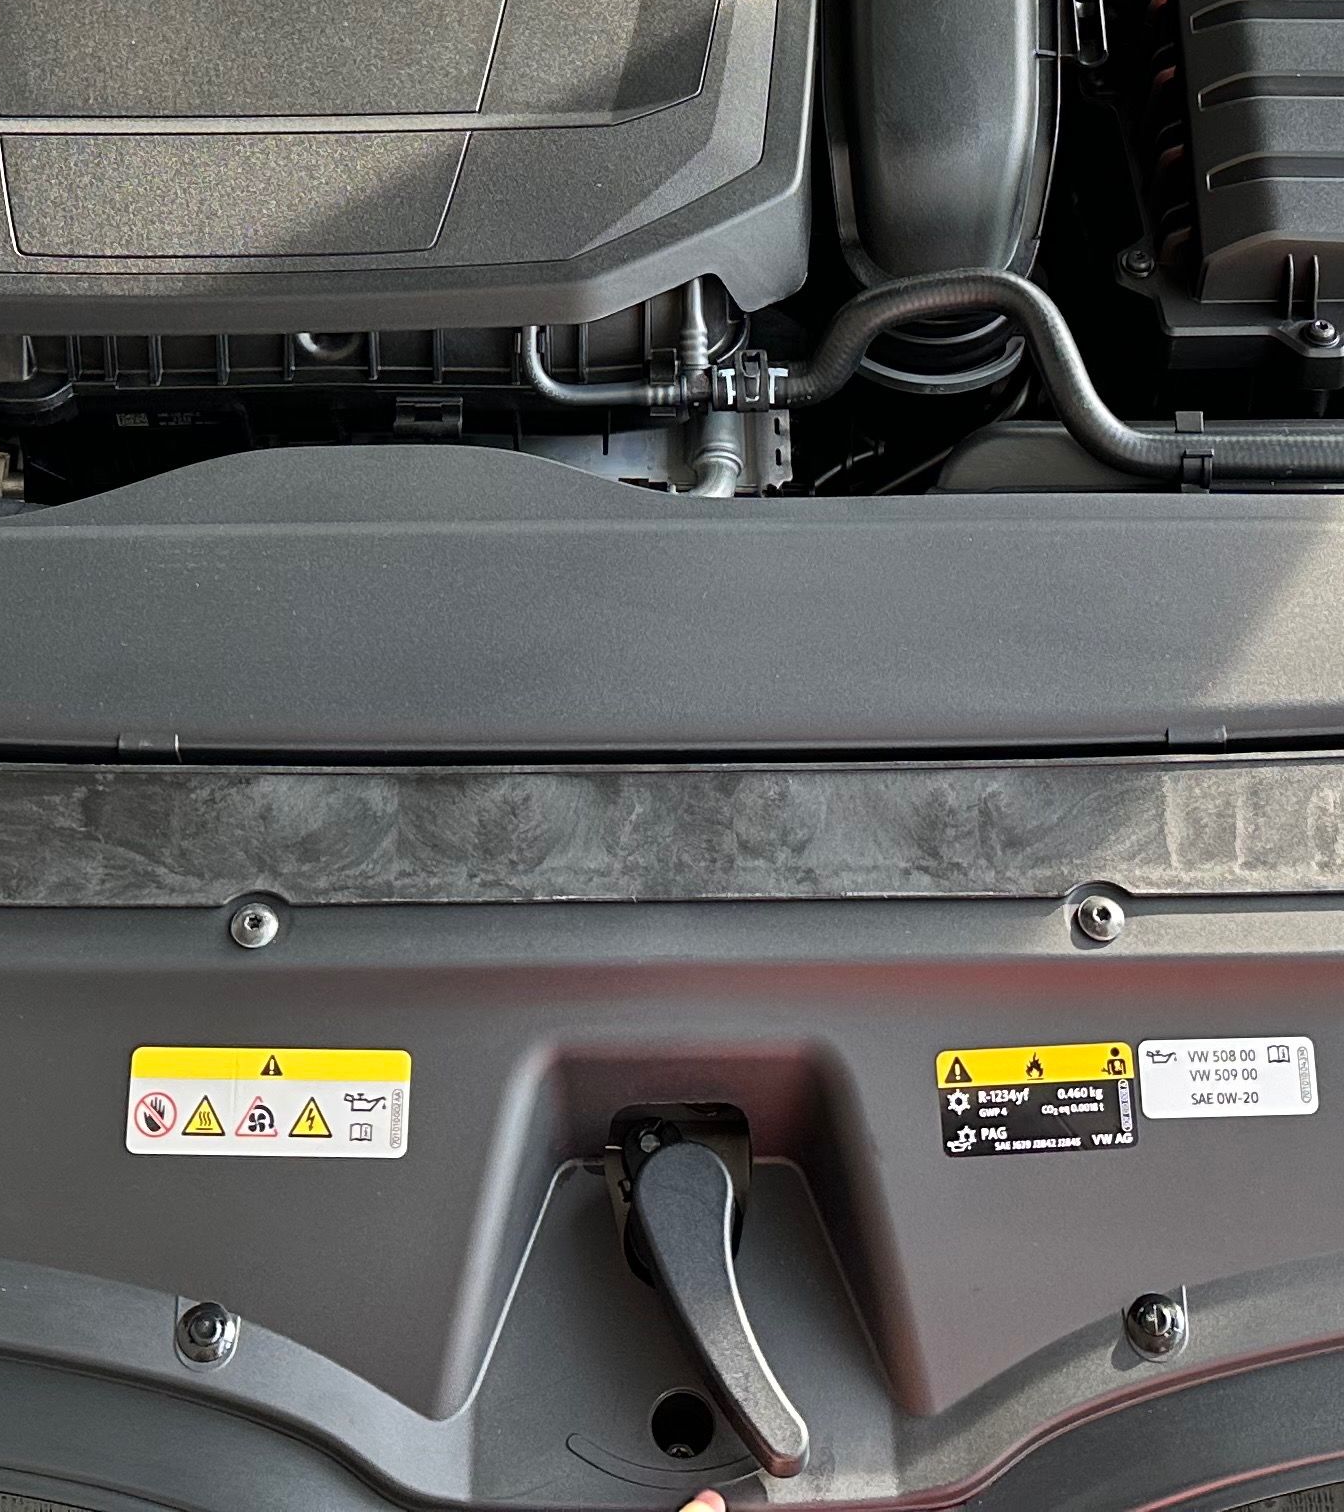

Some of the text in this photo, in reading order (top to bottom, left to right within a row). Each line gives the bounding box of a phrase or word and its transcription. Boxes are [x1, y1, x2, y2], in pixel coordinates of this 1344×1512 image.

[1188, 1049, 1256, 1063] VW 508 00
[1189, 1068, 1258, 1082] VW 509 00
[977, 1087, 1104, 1105] R-1234yf 0.460 kg
[1191, 1091, 1259, 1106] SAE 0W-20
[978, 1107, 1000, 1118] GWP
[980, 1126, 1008, 1140] PAG
[994, 1139, 1011, 1151] SAE
[1092, 1133, 1113, 1146] VW
[1114, 1132, 1133, 1144] AG
